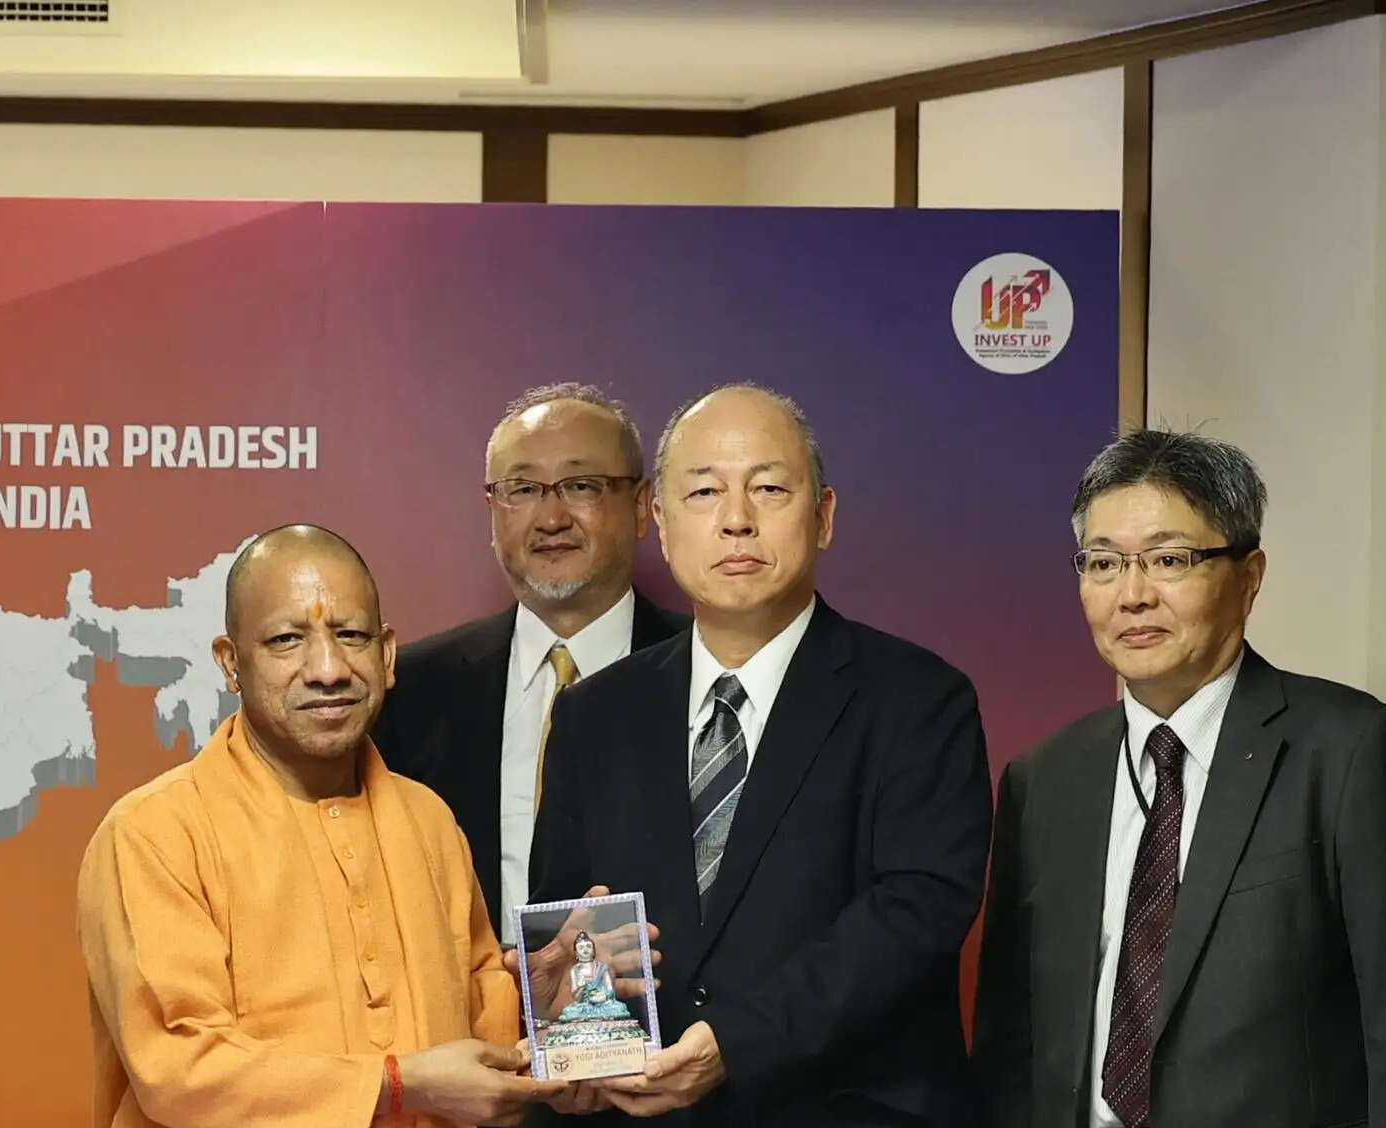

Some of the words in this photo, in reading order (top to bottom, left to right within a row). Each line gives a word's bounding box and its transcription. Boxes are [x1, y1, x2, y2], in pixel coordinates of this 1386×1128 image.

[974, 334, 1027, 346] INVEST
[1031, 334, 1051, 346] UP
[122, 425, 318, 469] PRADESH
